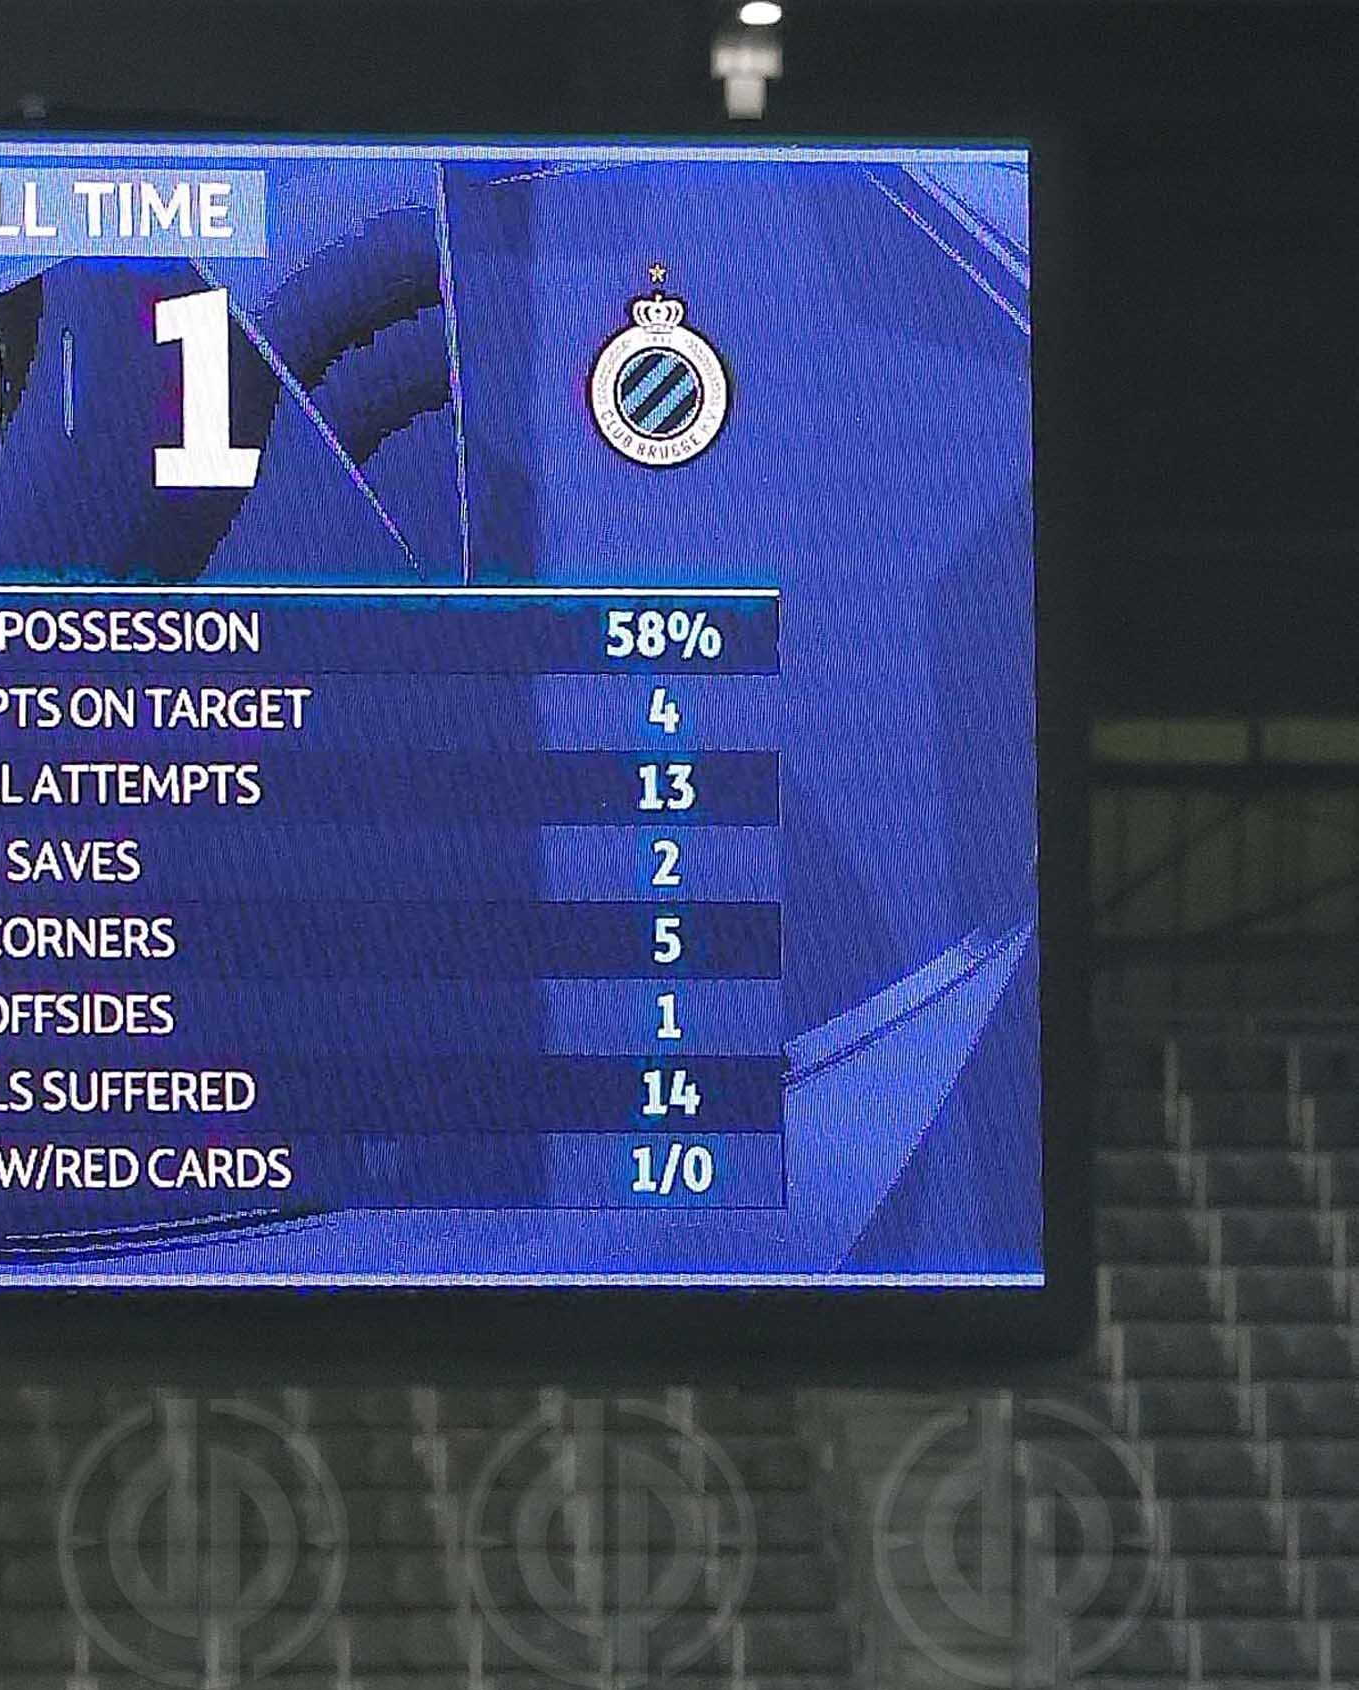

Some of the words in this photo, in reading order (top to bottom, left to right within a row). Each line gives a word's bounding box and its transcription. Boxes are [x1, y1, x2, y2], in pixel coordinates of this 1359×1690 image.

[74, 182, 234, 238] TIME
[155, 288, 262, 488] 1
[605, 610, 722, 660] 58%
[69, 686, 136, 730] ON
[144, 686, 313, 731] TARGET
[649, 688, 680, 734] 4
[31, 762, 262, 806] ATTEMPTS
[638, 763, 696, 812] 13
[5, 839, 142, 883] SAVES
[651, 840, 682, 886] 2
[653, 916, 683, 964] 5
[657, 993, 683, 1039] 1
[41, 1070, 257, 1114] SUFFERED
[642, 1069, 700, 1117] 14
[147, 1146, 294, 1191] CARDS
[632, 1144, 712, 1195] 1/0
